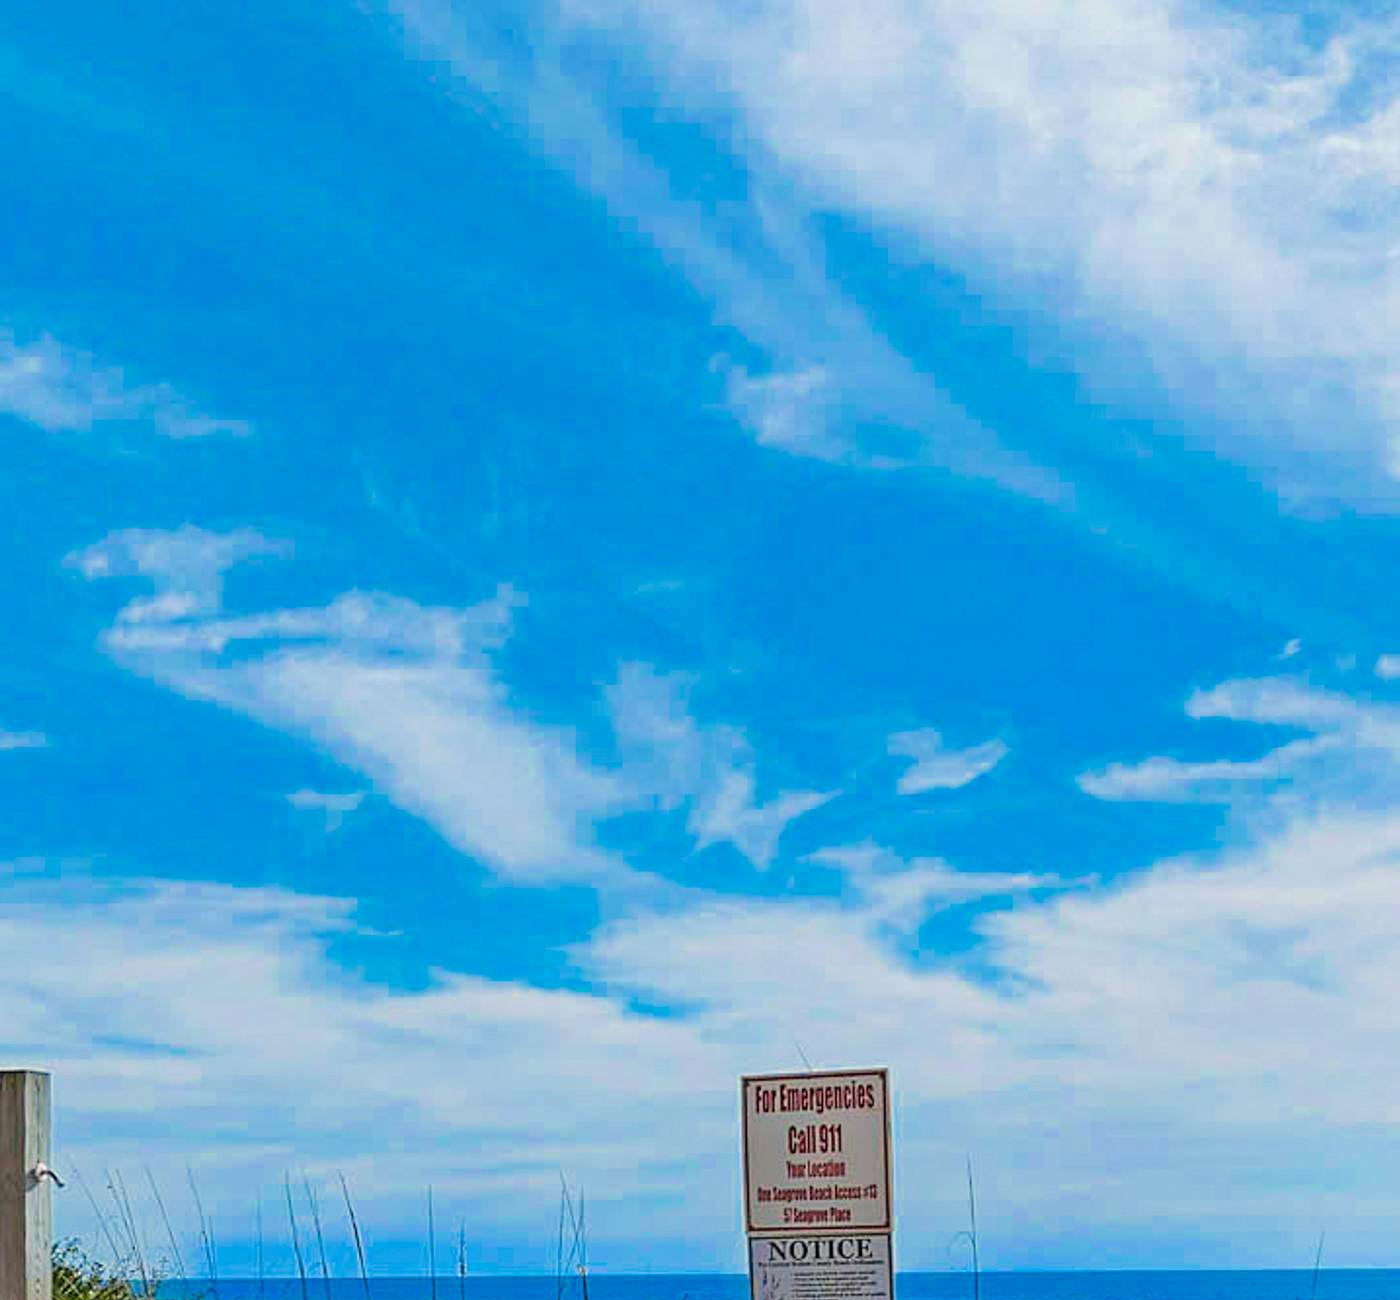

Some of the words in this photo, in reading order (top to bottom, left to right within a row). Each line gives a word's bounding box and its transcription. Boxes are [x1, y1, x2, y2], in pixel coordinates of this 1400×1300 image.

[755, 1086, 776, 1113] For
[780, 1081, 875, 1113] Emergencies
[788, 1126, 816, 1154] Call
[819, 1124, 842, 1153] 911
[786, 1161, 805, 1178] Your
[807, 1160, 845, 1178] Location
[809, 1185, 832, 1200] Beach
[834, 1184, 860, 1199] Access
[830, 1206, 851, 1222] Place
[768, 1238, 873, 1261] NOTICE
